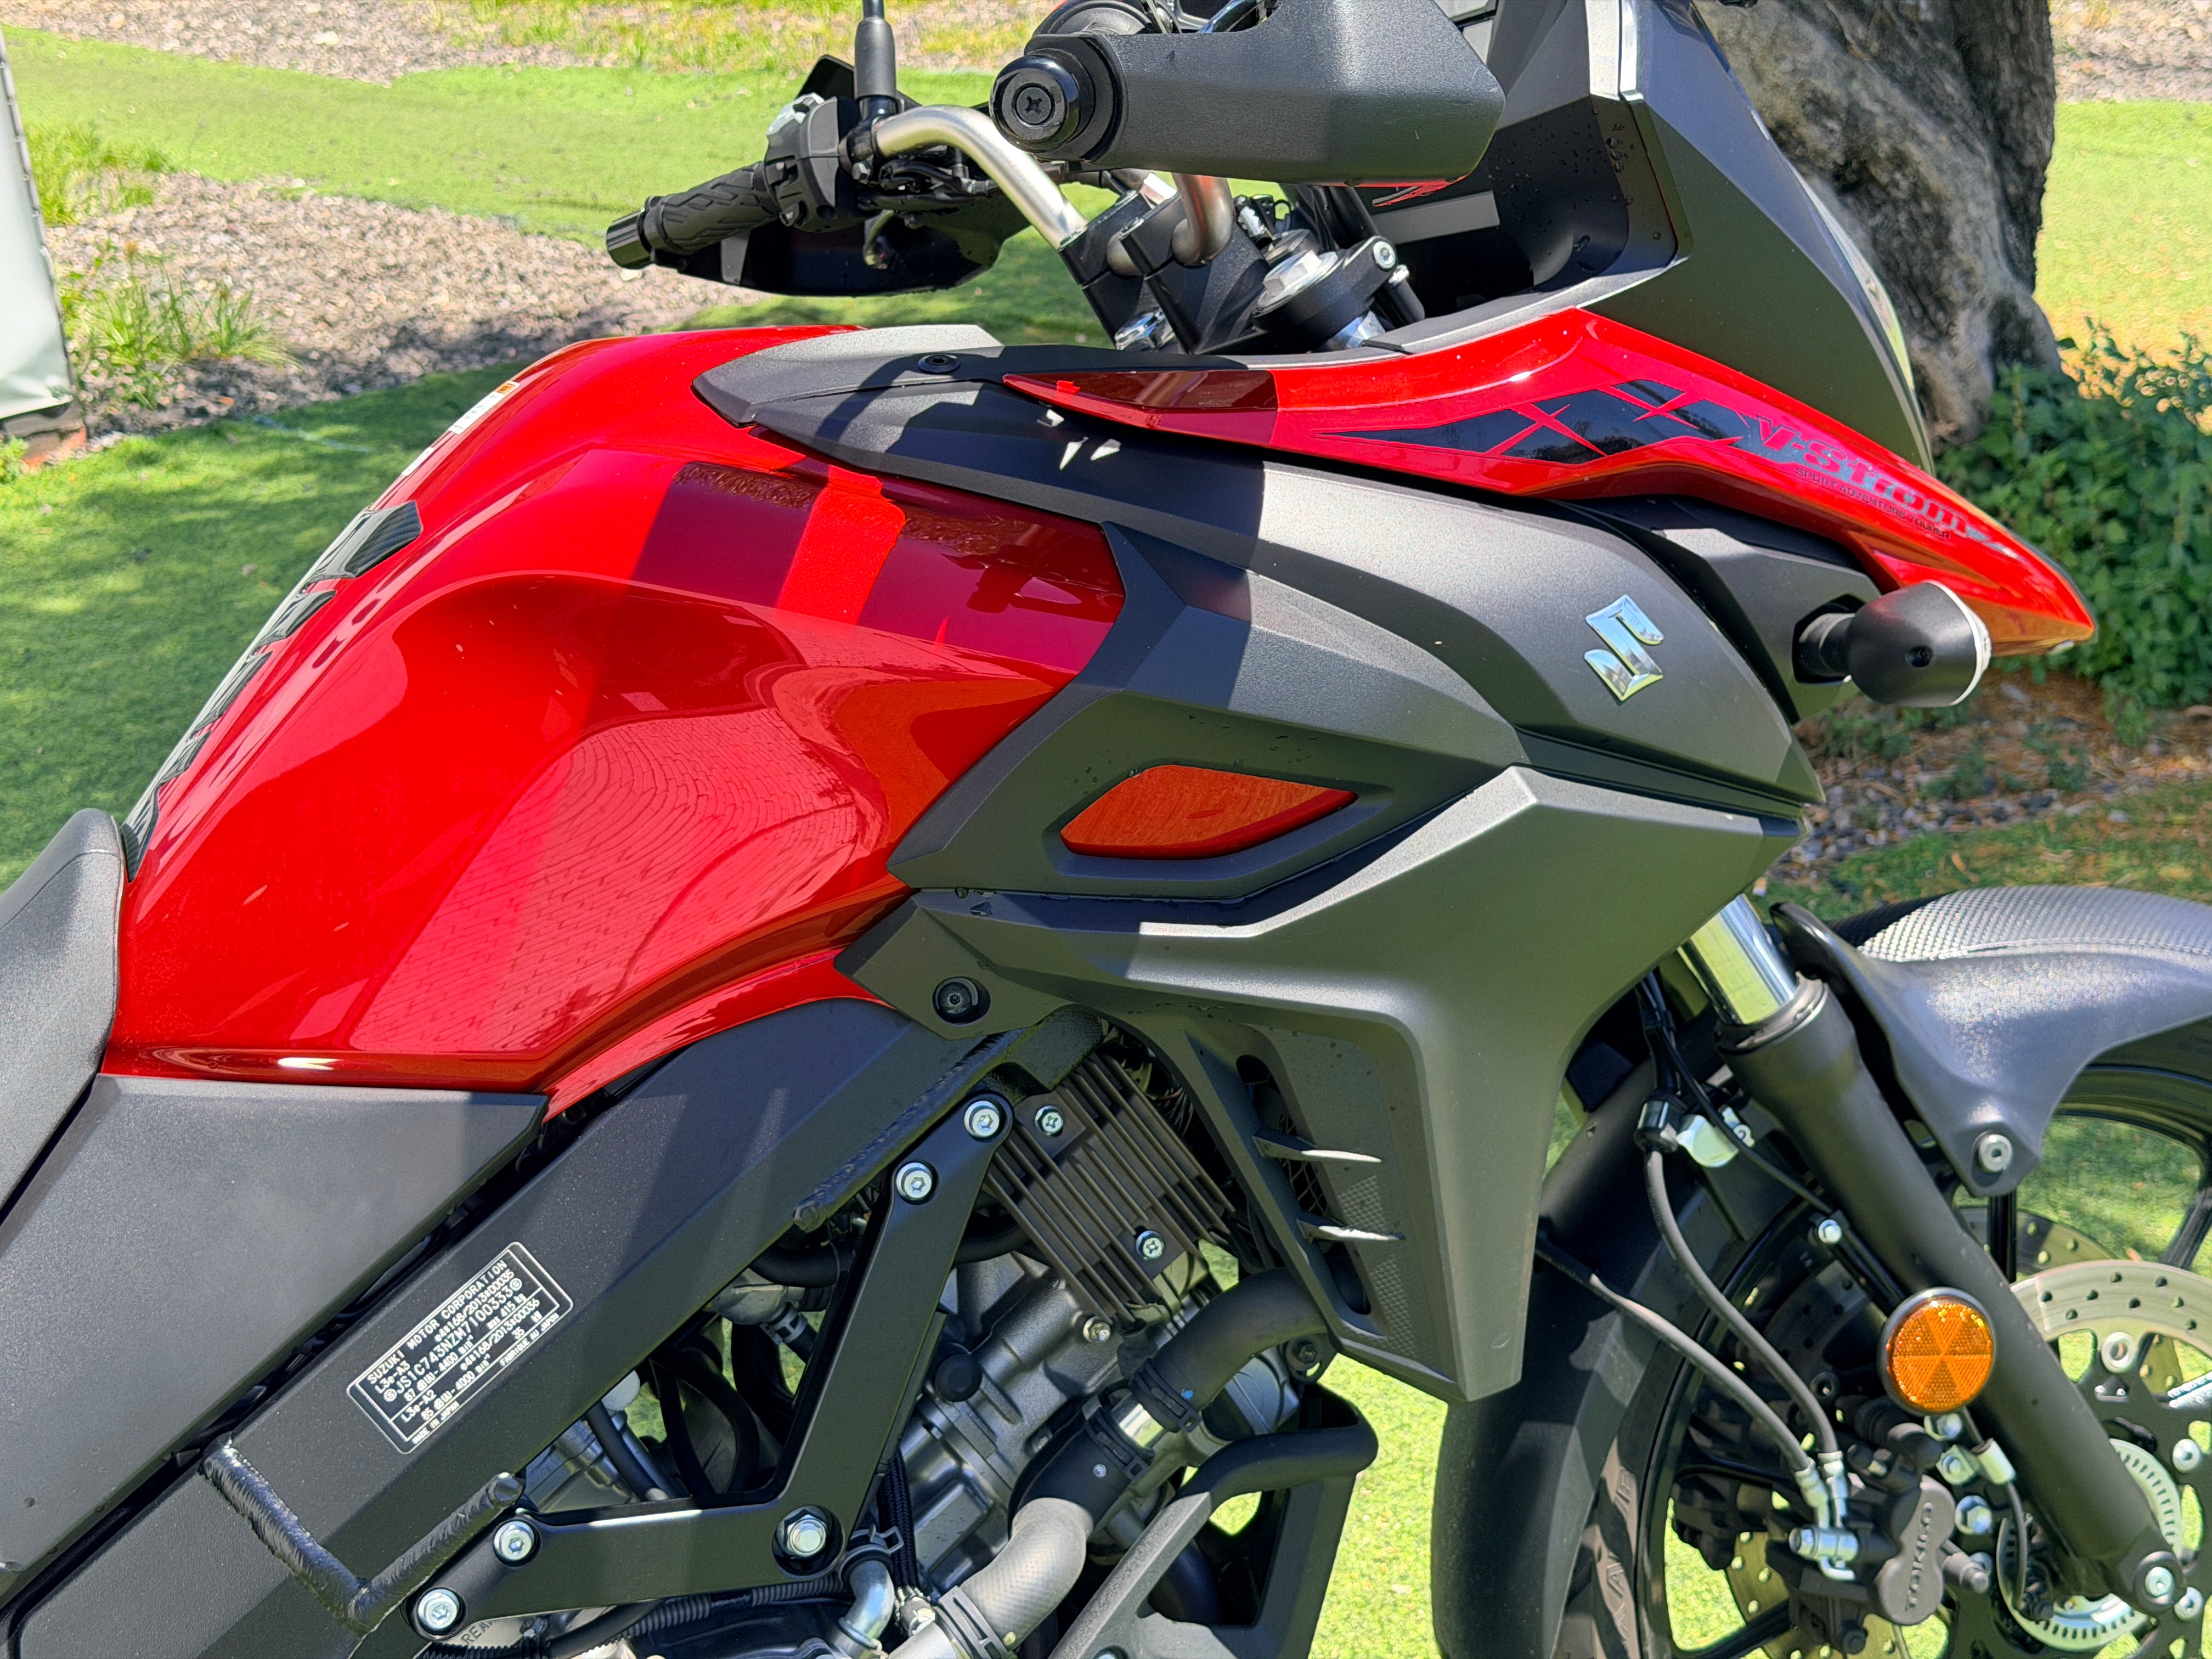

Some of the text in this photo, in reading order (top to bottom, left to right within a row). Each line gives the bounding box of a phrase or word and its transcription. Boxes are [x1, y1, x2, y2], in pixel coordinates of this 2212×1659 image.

[1757, 416, 1968, 533] V-Strom
[1796, 467, 1950, 540] SPORT ADVENTURE TOURER
[366, 1260, 507, 1384] SUZUKI MOTOR CORPORATION
[511, 1326, 525, 1340] 35
[529, 1329, 540, 1340] AU
[540, 1312, 560, 1332] JAPON
[403, 1387, 416, 1402] 87
[500, 1300, 516, 1317] 415
[512, 1293, 527, 1304] kg
[374, 1359, 410, 1393] L3e-A3
[400, 1389, 437, 1423] L3e-A2
[411, 1400, 460, 1444] MADE IN JAPAN
